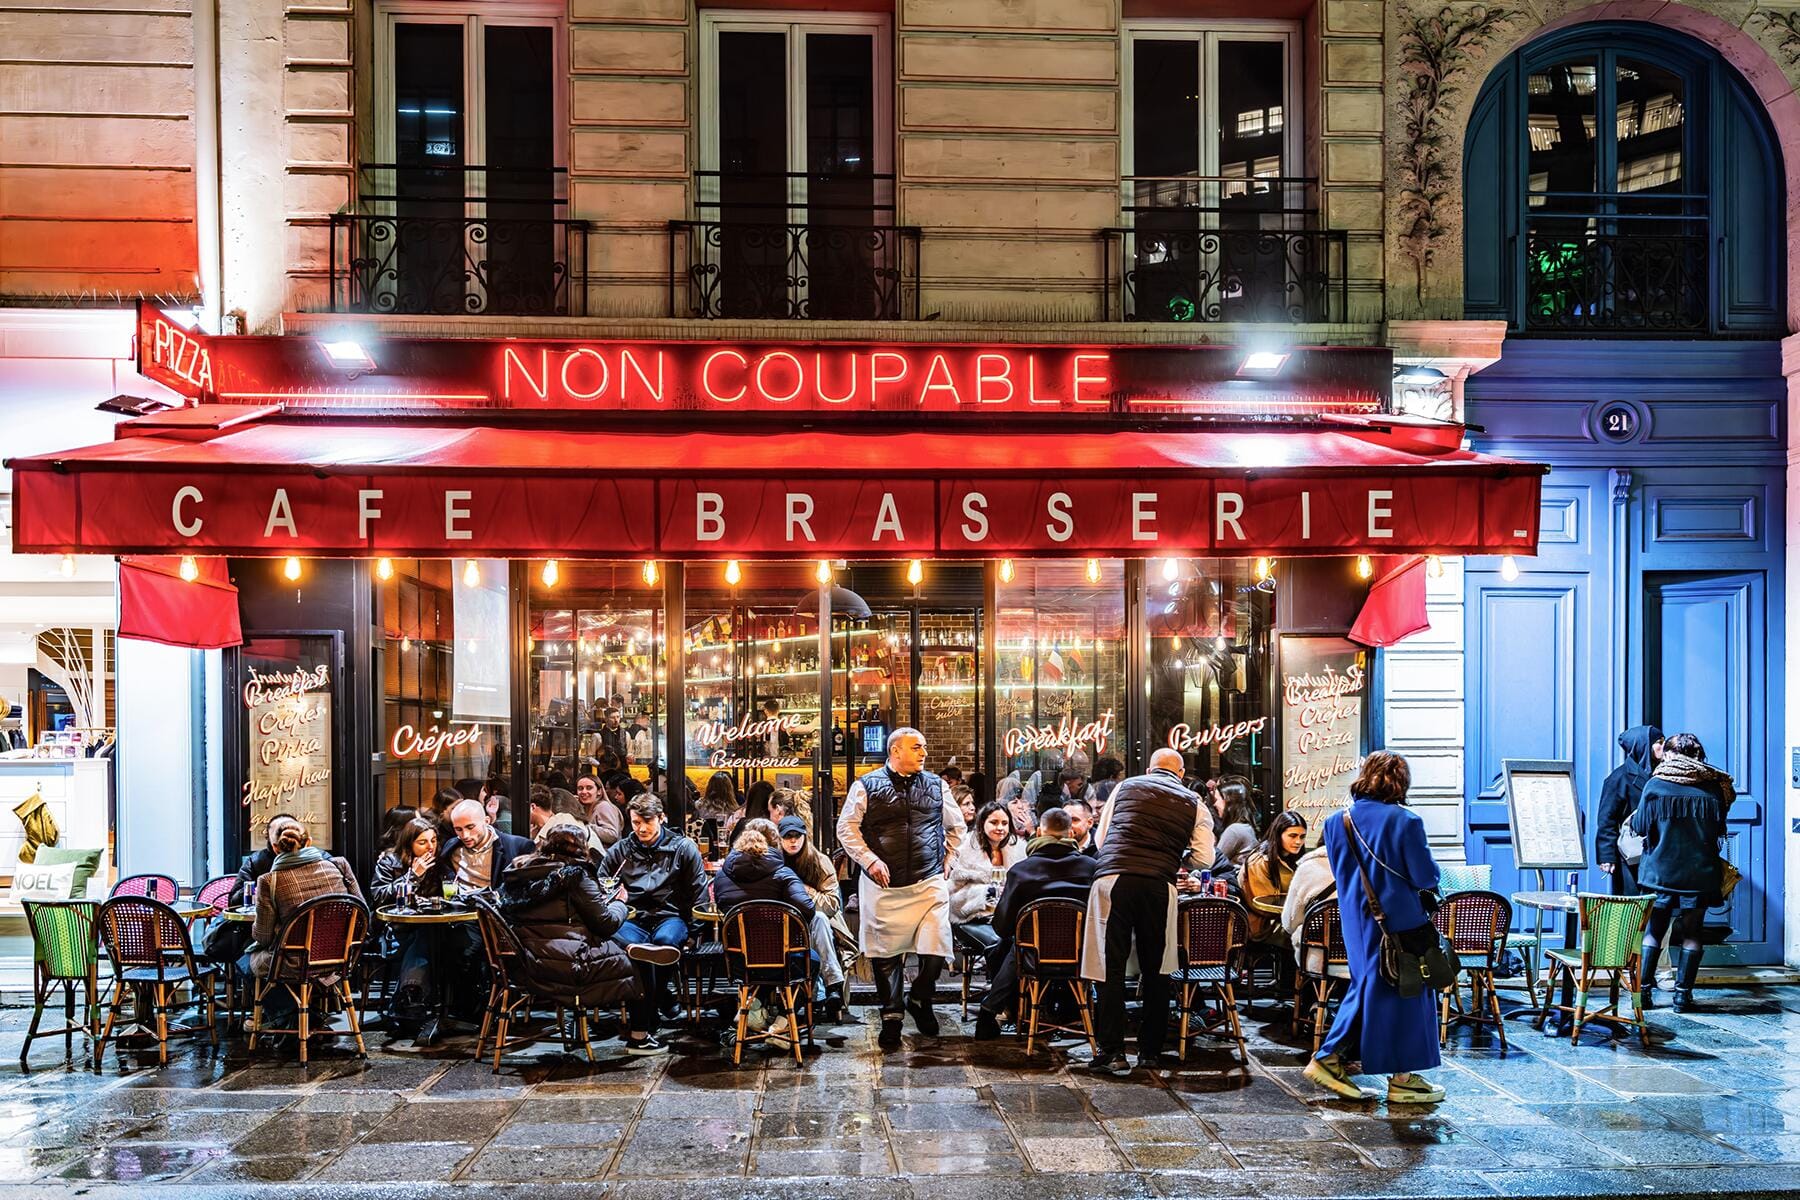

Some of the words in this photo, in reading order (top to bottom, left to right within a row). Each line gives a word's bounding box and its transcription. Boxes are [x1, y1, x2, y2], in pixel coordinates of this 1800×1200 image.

[155, 318, 214, 394] PIZZA
[503, 347, 664, 402] NON
[702, 350, 1110, 404] COUPABLE
[1609, 414, 1627, 431] 21
[171, 485, 474, 541] CAFE
[696, 490, 1394, 543] BRASSERIE
[243, 668, 329, 710] Breakfast
[1285, 670, 1365, 708] Breakfast
[391, 723, 483, 765] Crêpes
[694, 712, 801, 748] Welcome
[1003, 707, 1115, 758] Breakfast
[1168, 716, 1268, 754] Burgers
[1299, 730, 1354, 755] Pizza
[710, 749, 800, 769] Bienvenue
